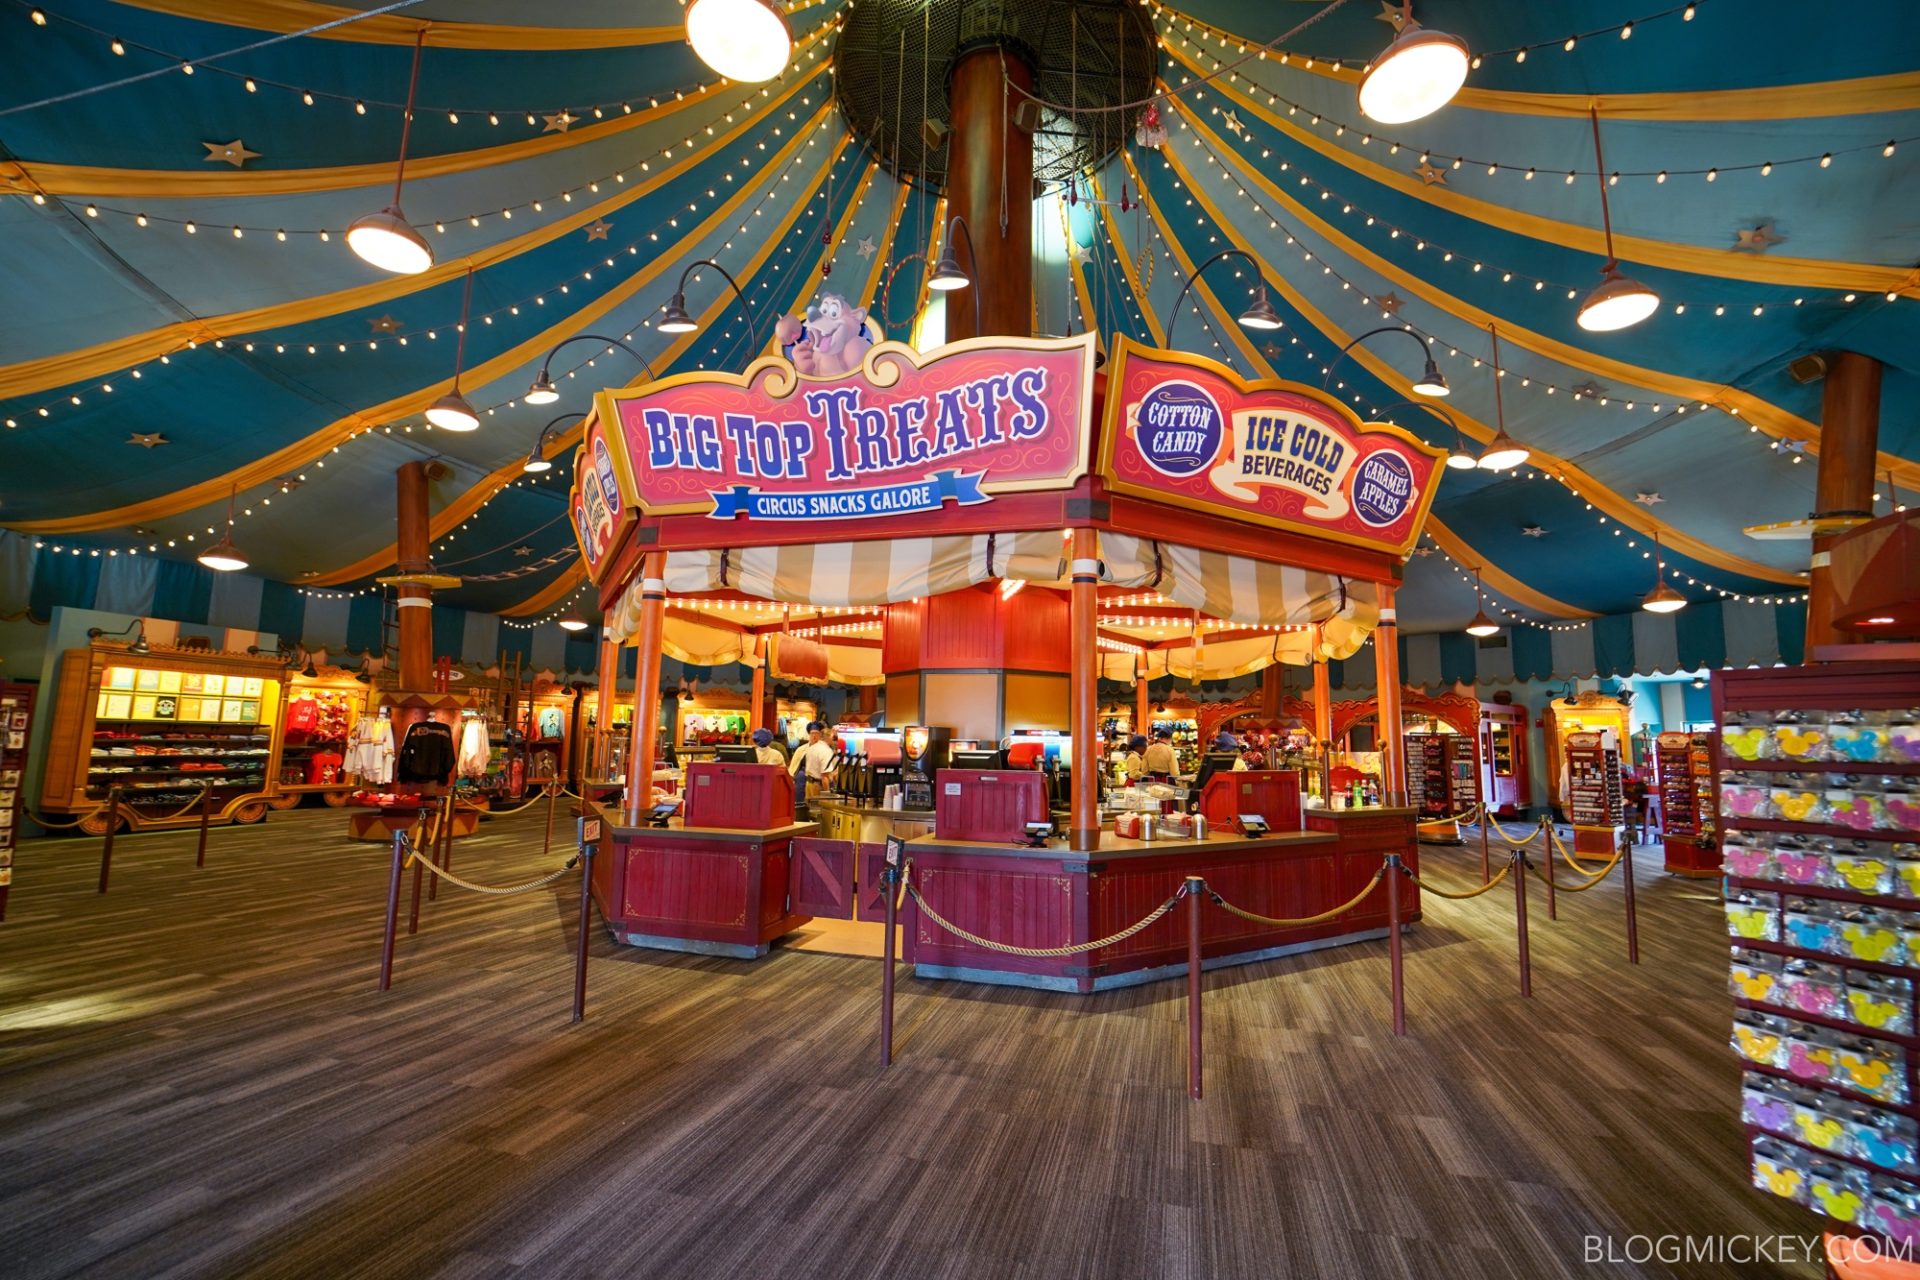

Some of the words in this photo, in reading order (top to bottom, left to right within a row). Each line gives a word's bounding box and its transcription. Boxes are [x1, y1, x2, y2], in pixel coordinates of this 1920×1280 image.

[642, 408, 723, 473] BIG
[723, 412, 814, 479] TOP
[803, 366, 1048, 481] TREATS
[1148, 401, 1212, 430] COTTON
[1152, 430, 1207, 455] CANDY
[1245, 416, 1287, 452] ICE
[1290, 422, 1345, 474] COLD
[1241, 454, 1333, 496] BEVERAGES
[1363, 460, 1409, 496] CARAMEL
[756, 497, 806, 515] CIRCUS
[810, 494, 867, 515] SNACKS
[870, 486, 931, 511] GALORE
[1358, 482, 1401, 516] APPLES
[585, 821, 599, 838] EXIT
